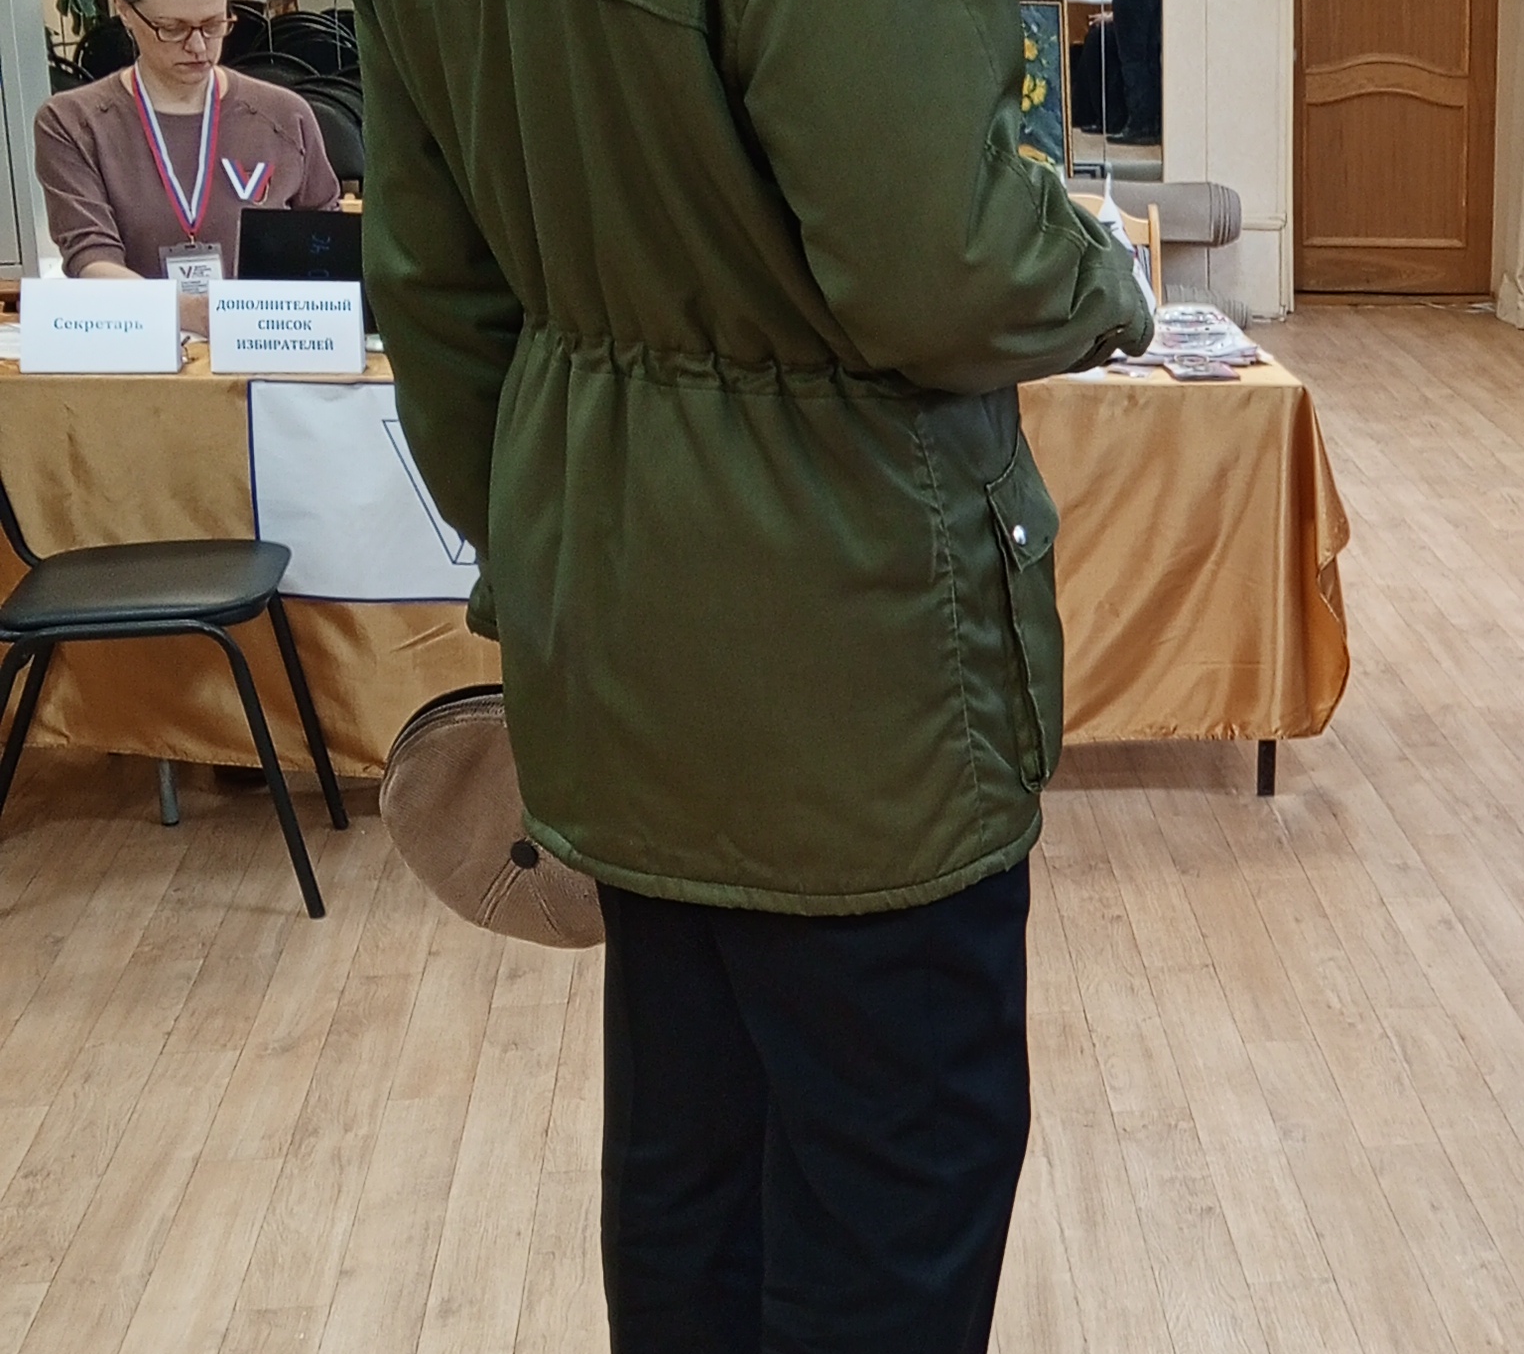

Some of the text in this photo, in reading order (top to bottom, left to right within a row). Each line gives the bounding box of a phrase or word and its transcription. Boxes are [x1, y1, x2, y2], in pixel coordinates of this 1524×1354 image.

[215, 298, 353, 313] ДОПОЛНИТЕЛЬНЫЙ
[53, 317, 144, 333] Секретарь
[256, 318, 313, 332] СПИСОК
[236, 337, 335, 352] ИЗБИРАТЕЛЕЙ
